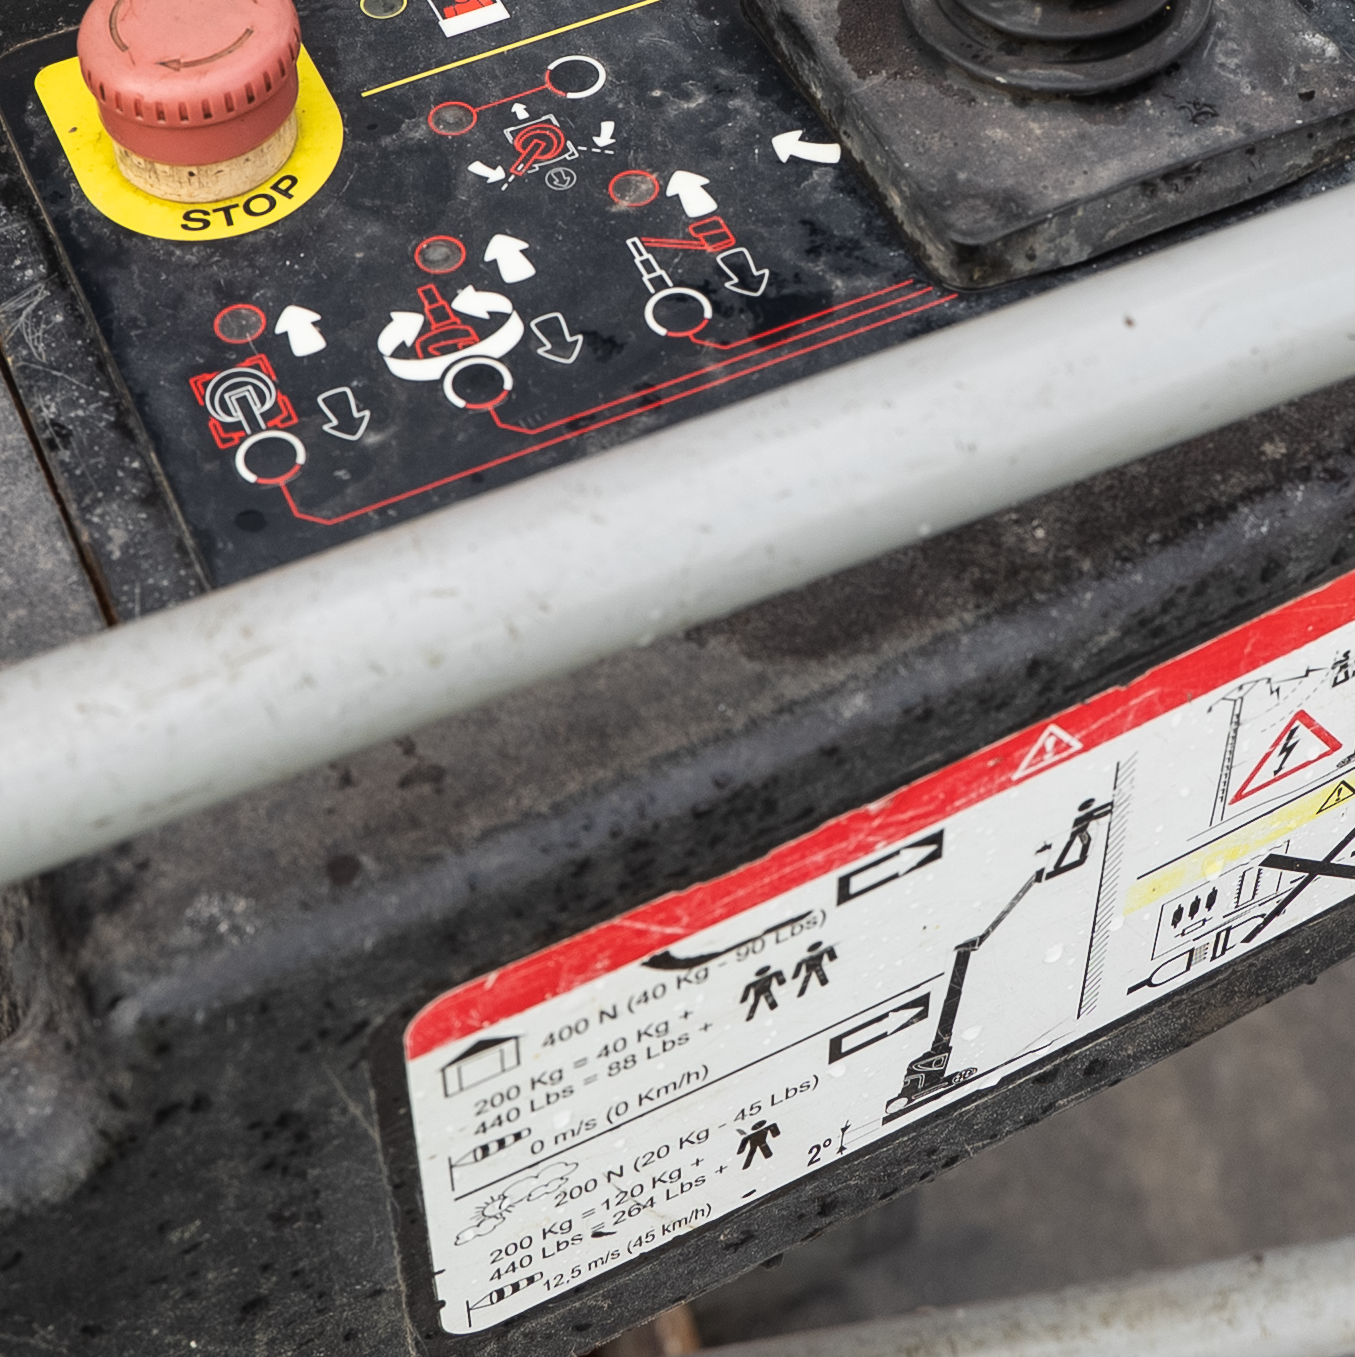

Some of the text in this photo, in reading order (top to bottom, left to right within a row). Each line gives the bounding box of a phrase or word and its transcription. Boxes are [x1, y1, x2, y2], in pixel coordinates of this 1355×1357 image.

[180, 174, 299, 232] STOP
[542, 1018, 590, 1050] 400
[598, 1004, 619, 1026] N
[627, 983, 667, 1015] (40
[676, 965, 710, 993] Kg
[736, 936, 766, 963] 90
[774, 909, 828, 947] Lbs)
[474, 1085, 522, 1118] 200
[530, 1067, 565, 1094] Kg
[573, 1056, 589, 1071] =
[597, 1036, 628, 1061] 40
[636, 1016, 670, 1043] Kg
[474, 1106, 521, 1137] 440
[530, 1084, 576, 1114] Lbs
[583, 1073, 599, 1087] =
[607, 1053, 638, 1078] 88
[646, 1031, 690, 1061] Lbs
[530, 1064, 710, 1156] 0 m/s (0 Km/h)
[554, 1178, 598, 1208] 200
[607, 1164, 624, 1184] N
[633, 1144, 670, 1174] (20
[679, 1128, 710, 1150] Kg
[733, 1100, 762, 1122] 45
[770, 1074, 819, 1107] Lbs)
[807, 1137, 833, 1167] 2°
[489, 1235, 533, 1265] 200
[542, 1219, 574, 1242] Kg
[581, 1205, 596, 1220] =
[601, 1184, 645, 1210] 120
[652, 1168, 682, 1190] Kg
[489, 1254, 533, 1282] 440
[541, 1234, 583, 1259] Lbs
[612, 1196, 656, 1226] 264
[665, 1175, 707, 1201] Lbs
[587, 1249, 622, 1273] m/s
[626, 1230, 657, 1255] (45
[661, 1202, 713, 1238] km/h)
